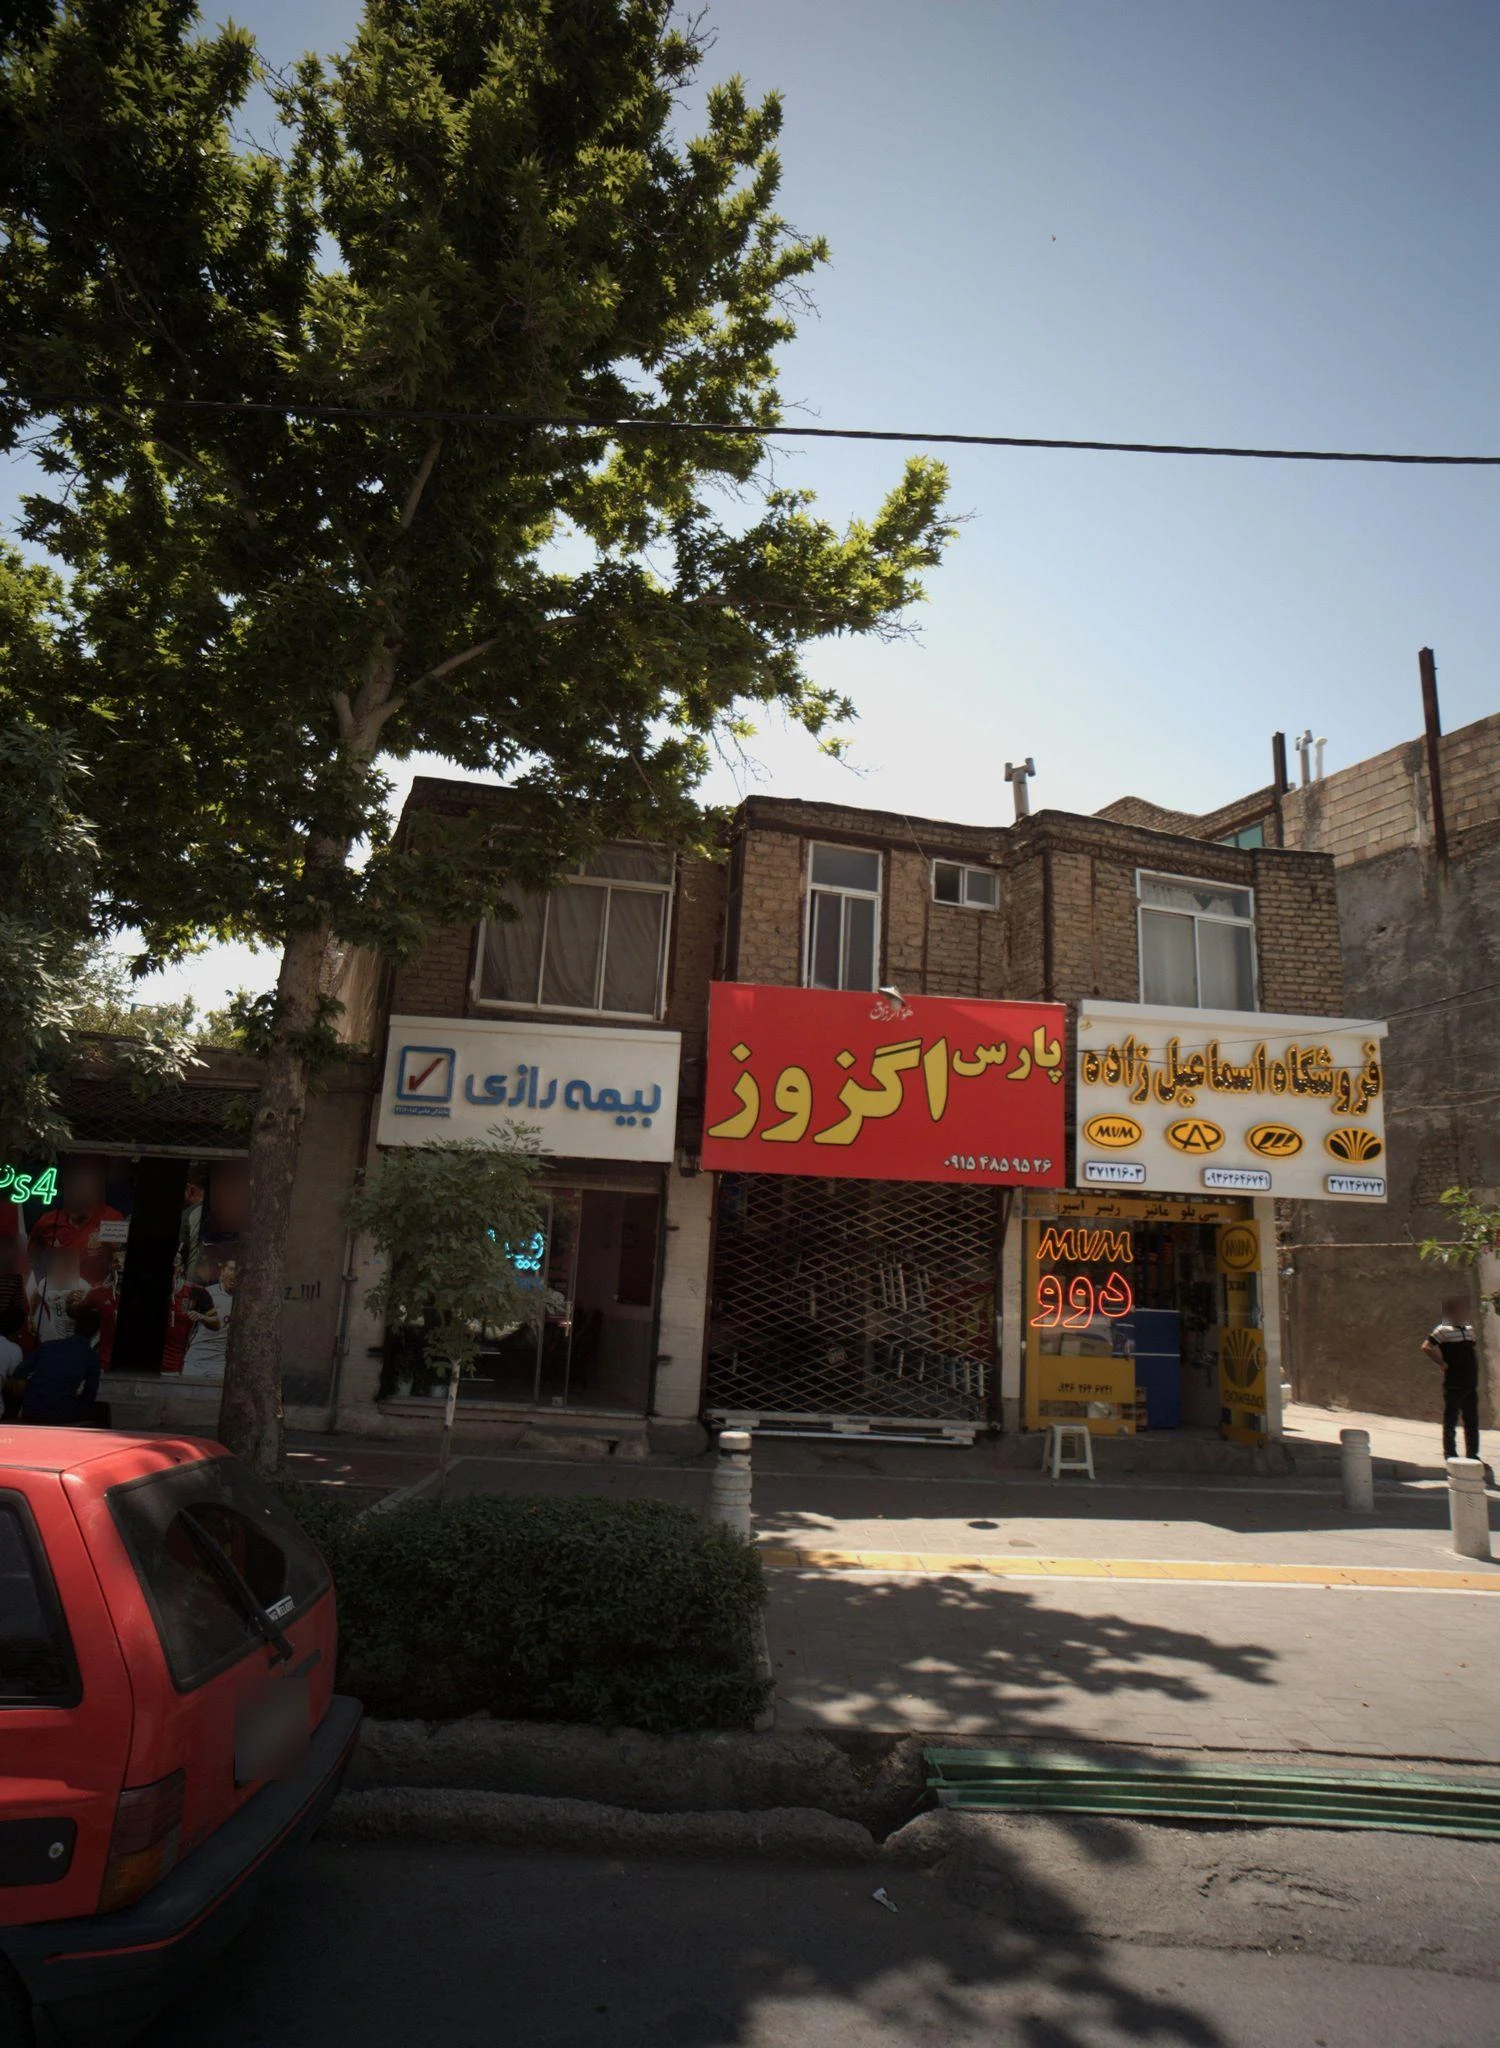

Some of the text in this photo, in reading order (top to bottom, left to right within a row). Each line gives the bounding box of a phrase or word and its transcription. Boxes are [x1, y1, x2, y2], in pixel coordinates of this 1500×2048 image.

[952, 1025, 1063, 1084] پارس
[1081, 1032, 1383, 1116] فروشگاه اسماعیل زاده
[464, 1063, 662, 1129] بیمه رازی
[706, 1036, 949, 1146] اگزوز
[1095, 1124, 1134, 1139] MVM
[944, 1154, 976, 1170] ۰۹۱۵
[979, 1156, 1010, 1172] ۴۸۵
[1012, 1157, 1031, 1173] ۹۵
[1036, 1227, 1134, 1263] MVM
[1029, 1271, 1132, 1329] دوو
